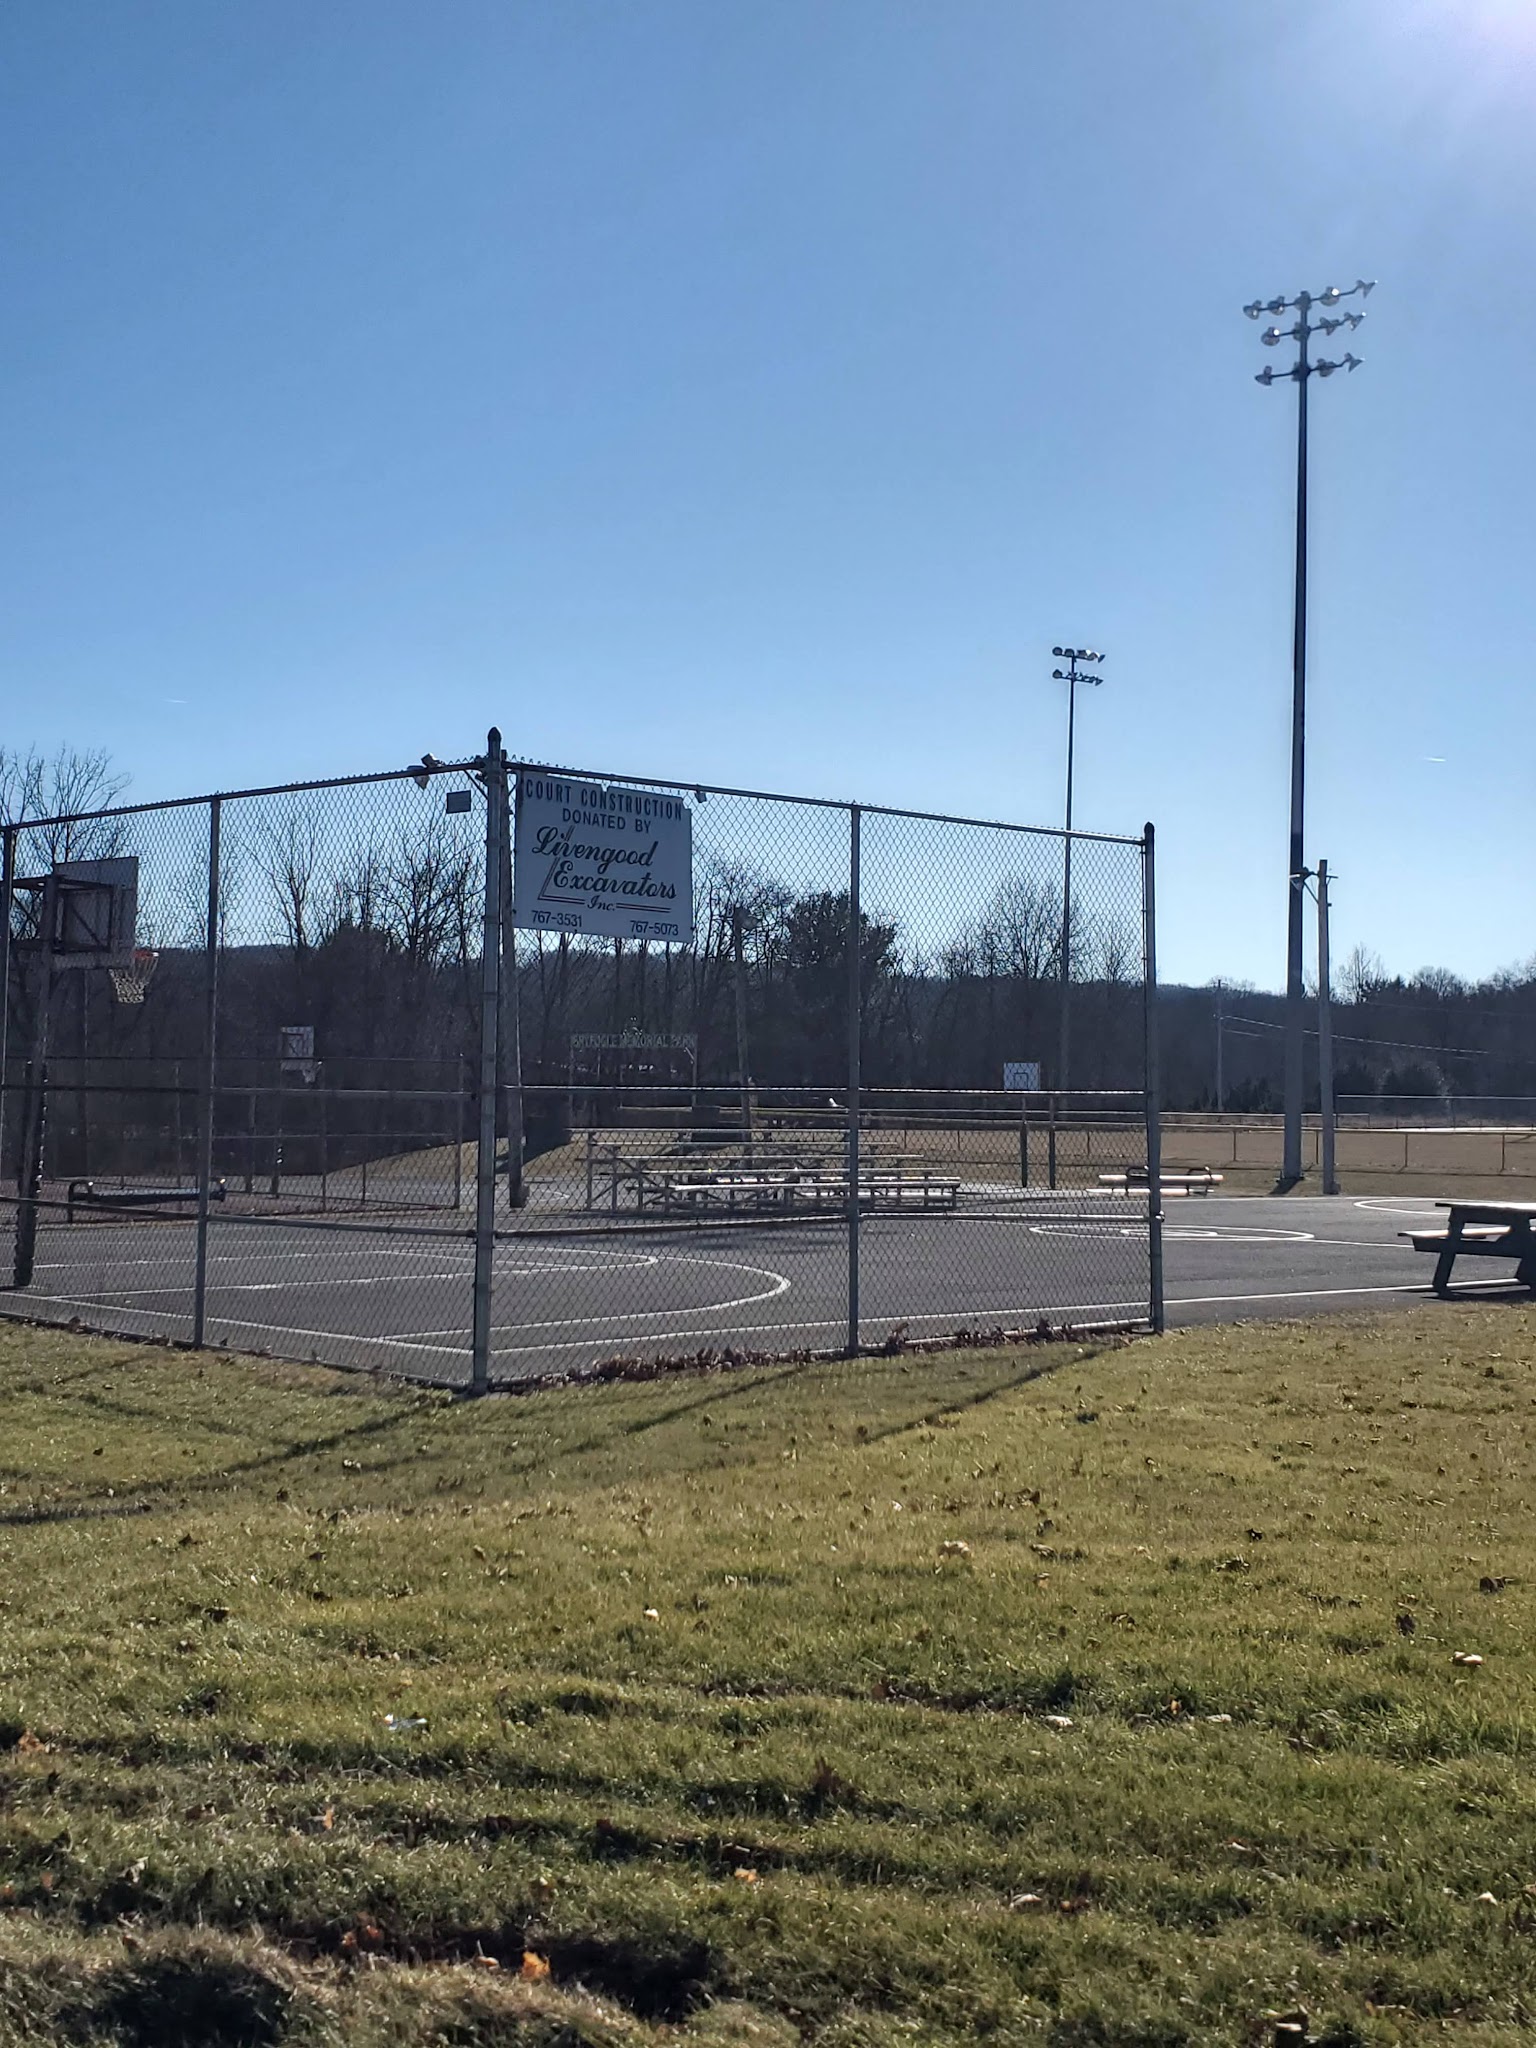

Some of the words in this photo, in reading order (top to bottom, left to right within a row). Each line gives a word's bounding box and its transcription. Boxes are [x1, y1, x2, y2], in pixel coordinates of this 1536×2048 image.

[526, 779, 572, 805] COURT
[581, 788, 682, 821] CONSTRUCTION
[563, 808, 626, 830] DONATED
[635, 819, 651, 833] BY
[532, 826, 659, 874] Livengood
[554, 860, 677, 899] Excavators
[587, 895, 615, 911] Inc.
[531, 910, 582, 927] 767-3531
[630, 920, 679, 936] 767-5073
